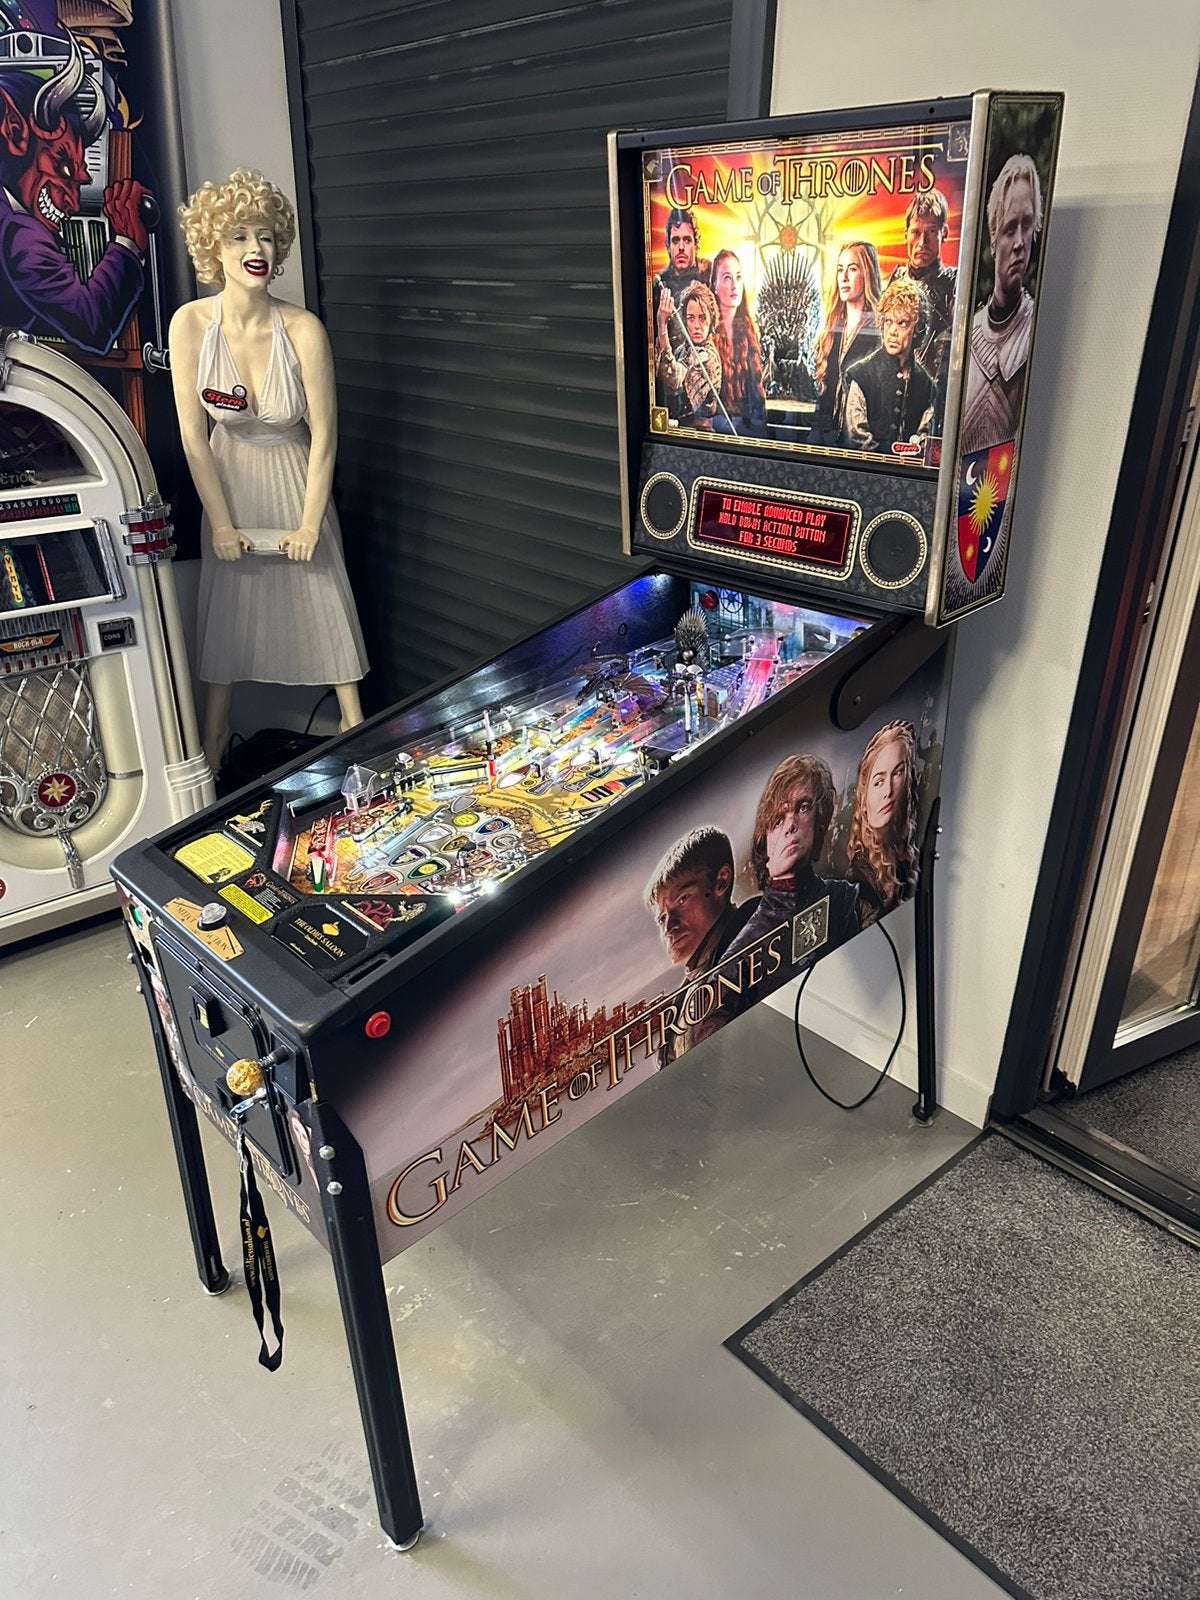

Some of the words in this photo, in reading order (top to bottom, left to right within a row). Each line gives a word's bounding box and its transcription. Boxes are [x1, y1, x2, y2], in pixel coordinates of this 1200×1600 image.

[665, 161, 754, 211] GAME
[757, 171, 781, 197] OF
[774, 142, 944, 206] THRONES
[206, 391, 243, 406] Stern
[20, 500, 26, 508] 5
[41, 498, 47, 506] 8
[48, 497, 54, 505] 9
[55, 496, 61, 504] 0
[722, 498, 732, 510] TO
[733, 499, 762, 516] ENABLE
[763, 505, 804, 523] ADVANCED
[804, 512, 828, 528] PLAY
[718, 511, 737, 526] HOLD
[738, 515, 761, 531] DOWN
[762, 520, 793, 538] ACTION
[794, 526, 827, 544] BUTTON
[738, 530, 754, 544] FOR
[763, 535, 799, 553] SECONDS
[103, 632, 122, 641] COINS
[304, 924, 325, 941] OLDIES
[320, 935, 347, 958] SALOON
[387, 1081, 562, 1228] GAME
[567, 1060, 603, 1100] OF
[592, 920, 790, 1091] THRONES
